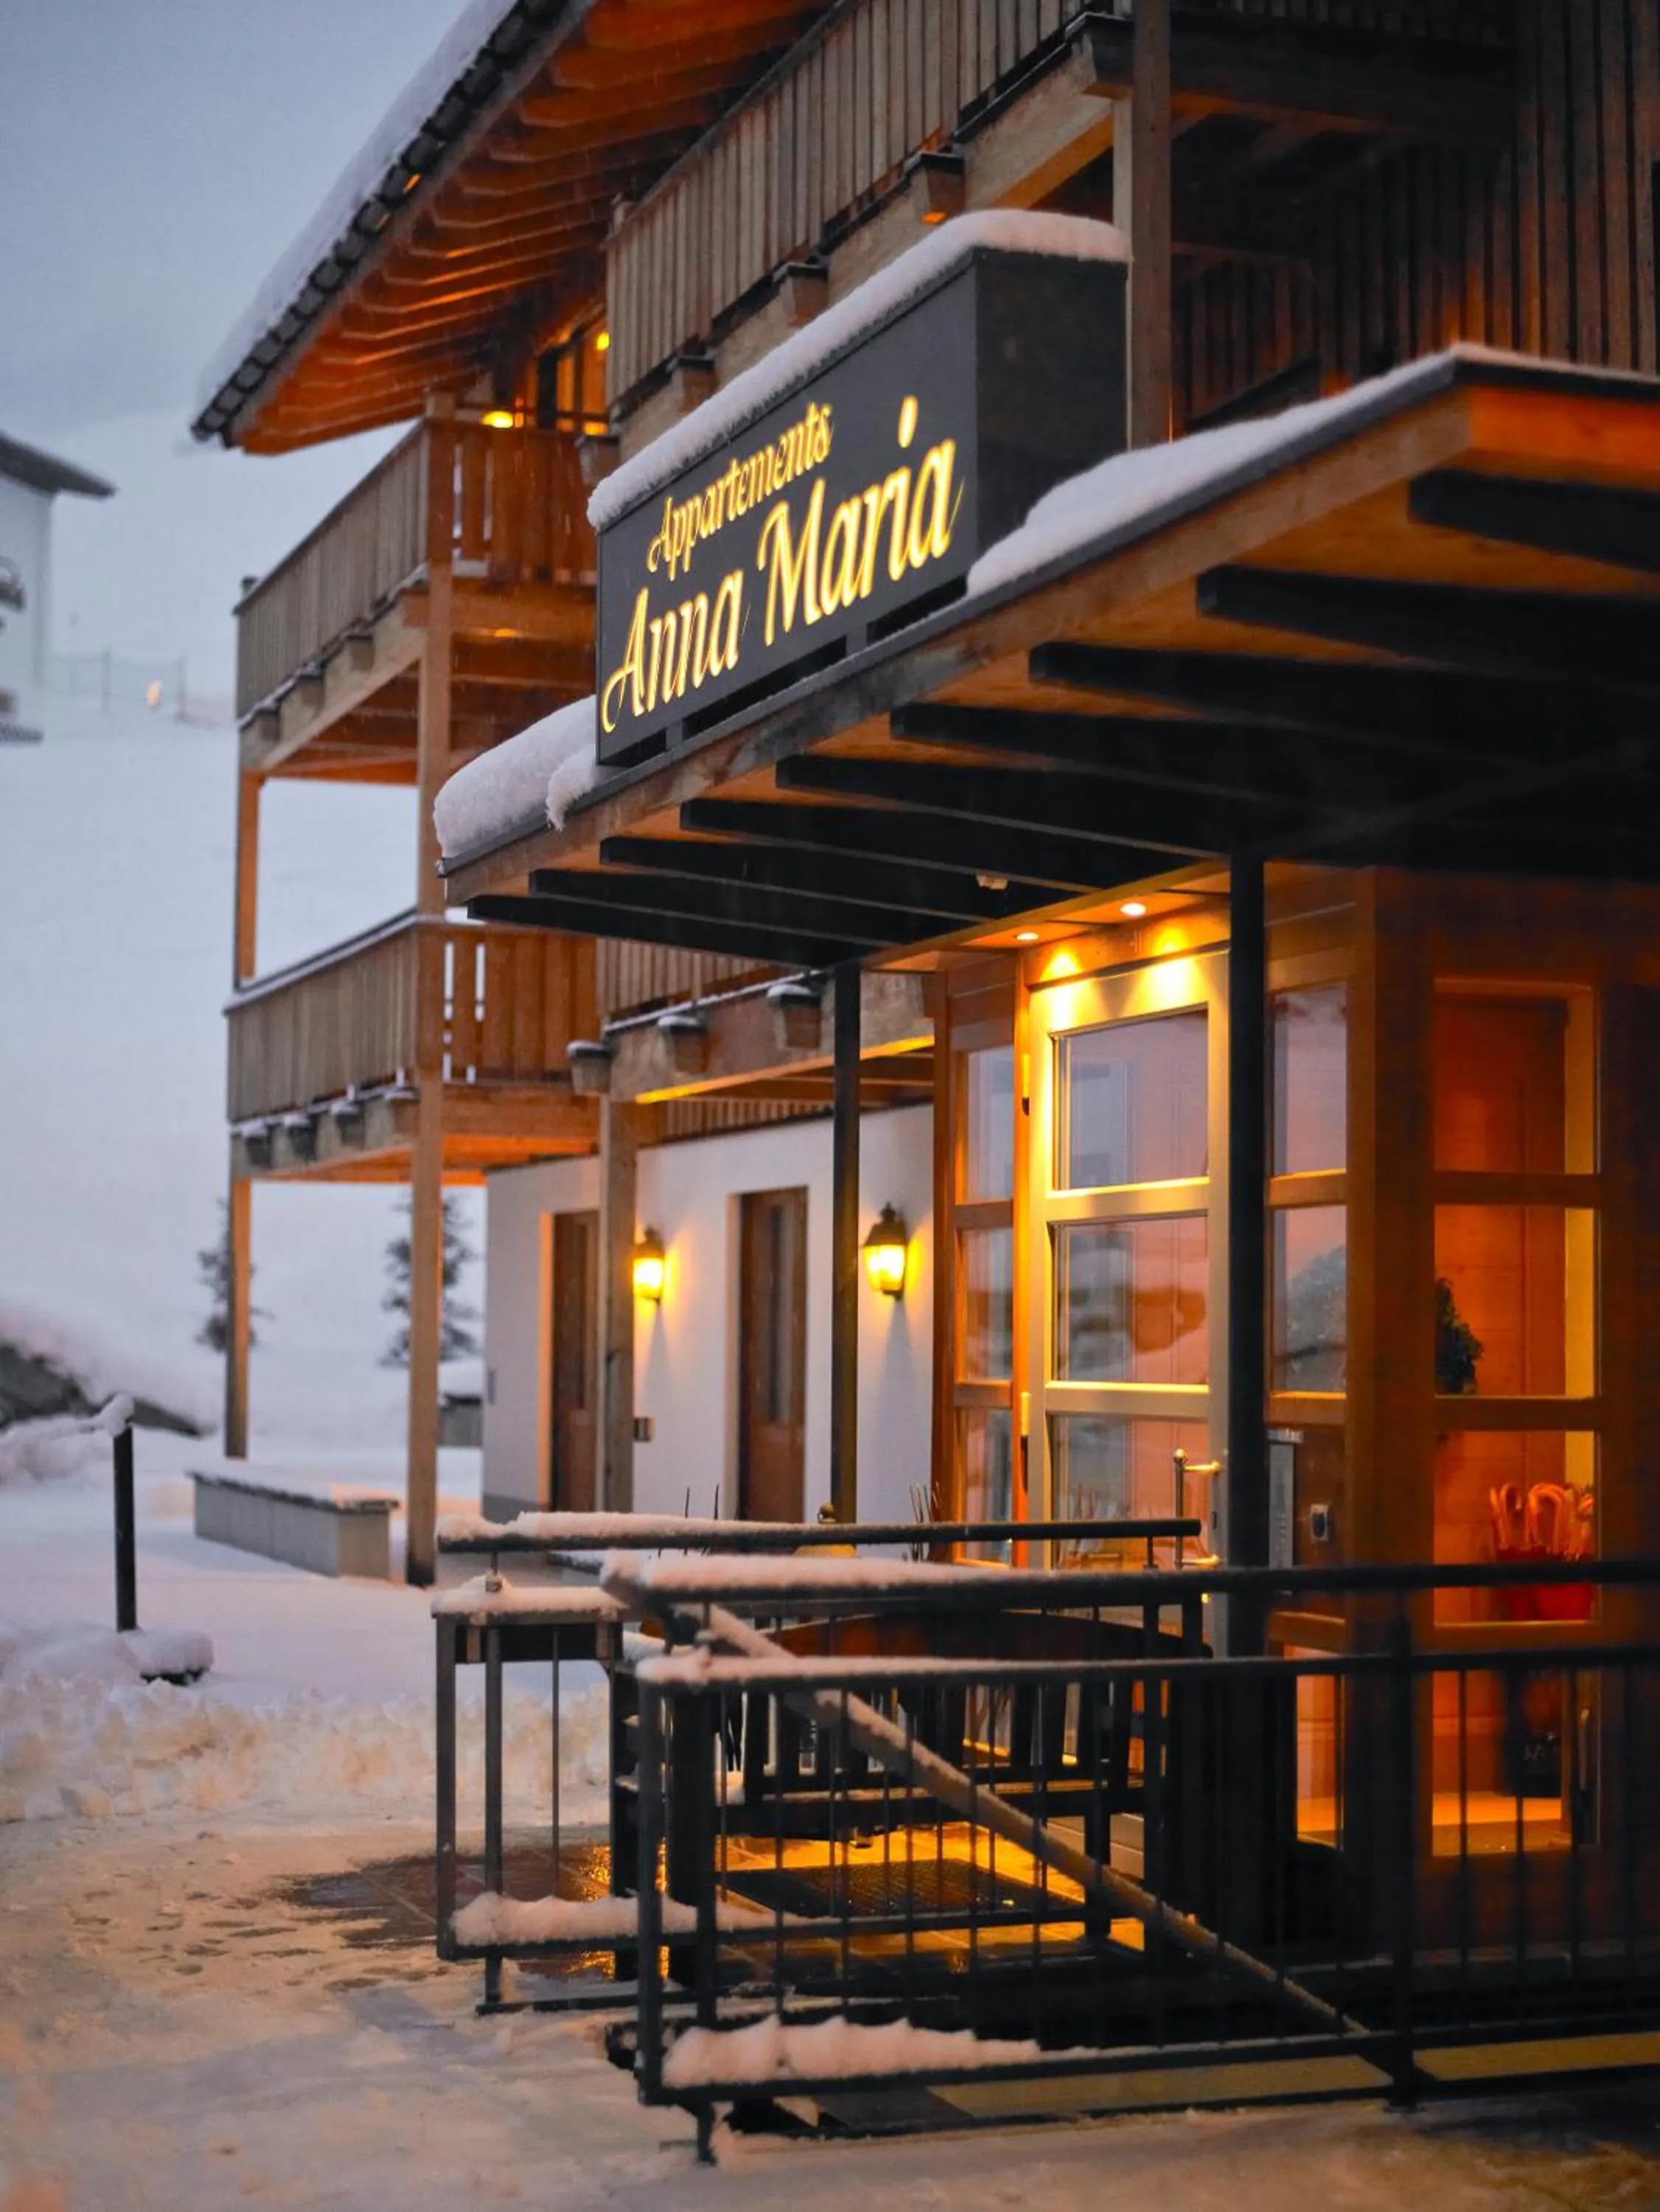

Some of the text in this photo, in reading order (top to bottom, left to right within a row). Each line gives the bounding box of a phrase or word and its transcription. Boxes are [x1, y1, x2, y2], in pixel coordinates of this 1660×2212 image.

[601, 395, 965, 733] Anna Maria
[646, 401, 834, 580] Appartements
